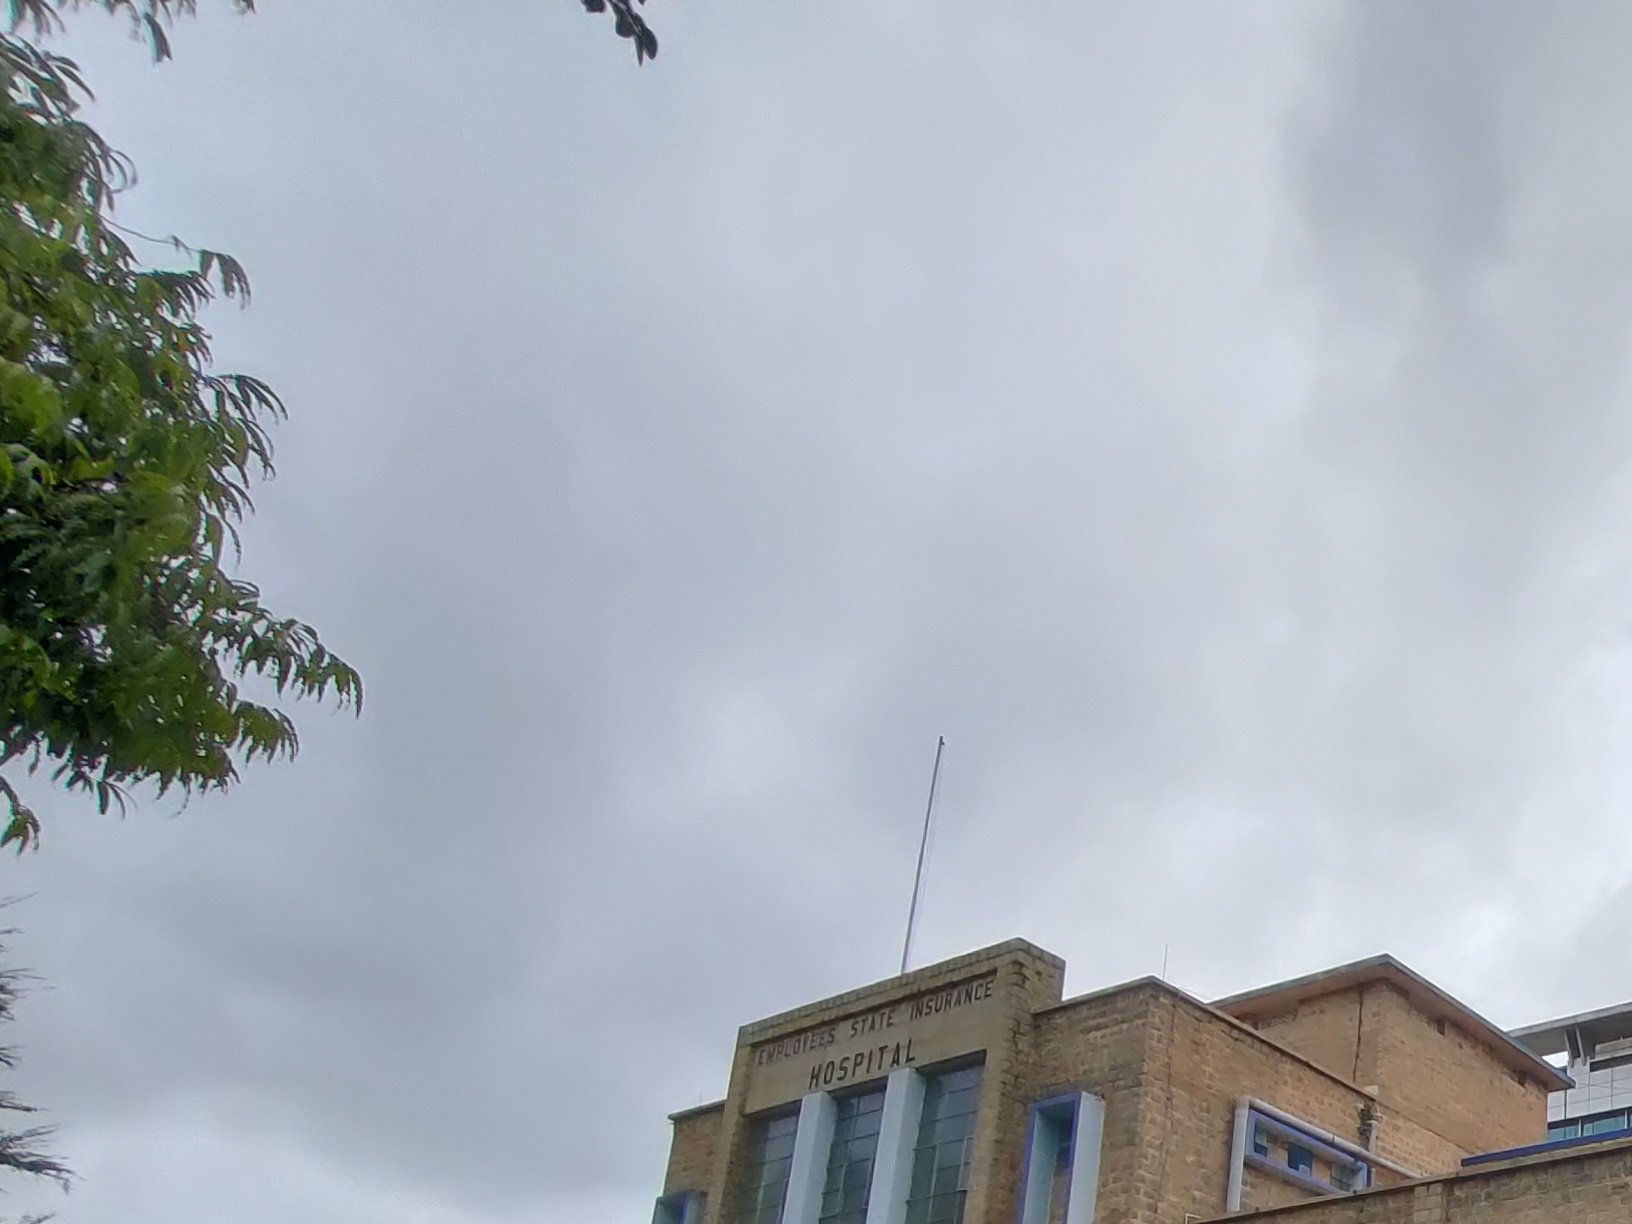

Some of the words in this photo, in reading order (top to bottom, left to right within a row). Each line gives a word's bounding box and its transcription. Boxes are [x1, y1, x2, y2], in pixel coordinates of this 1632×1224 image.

[757, 1027, 837, 1066] EMPLOYEES
[849, 1009, 895, 1038] STATE
[909, 980, 994, 1021] INSURANCE
[808, 1038, 917, 1090] HOSPITAL
